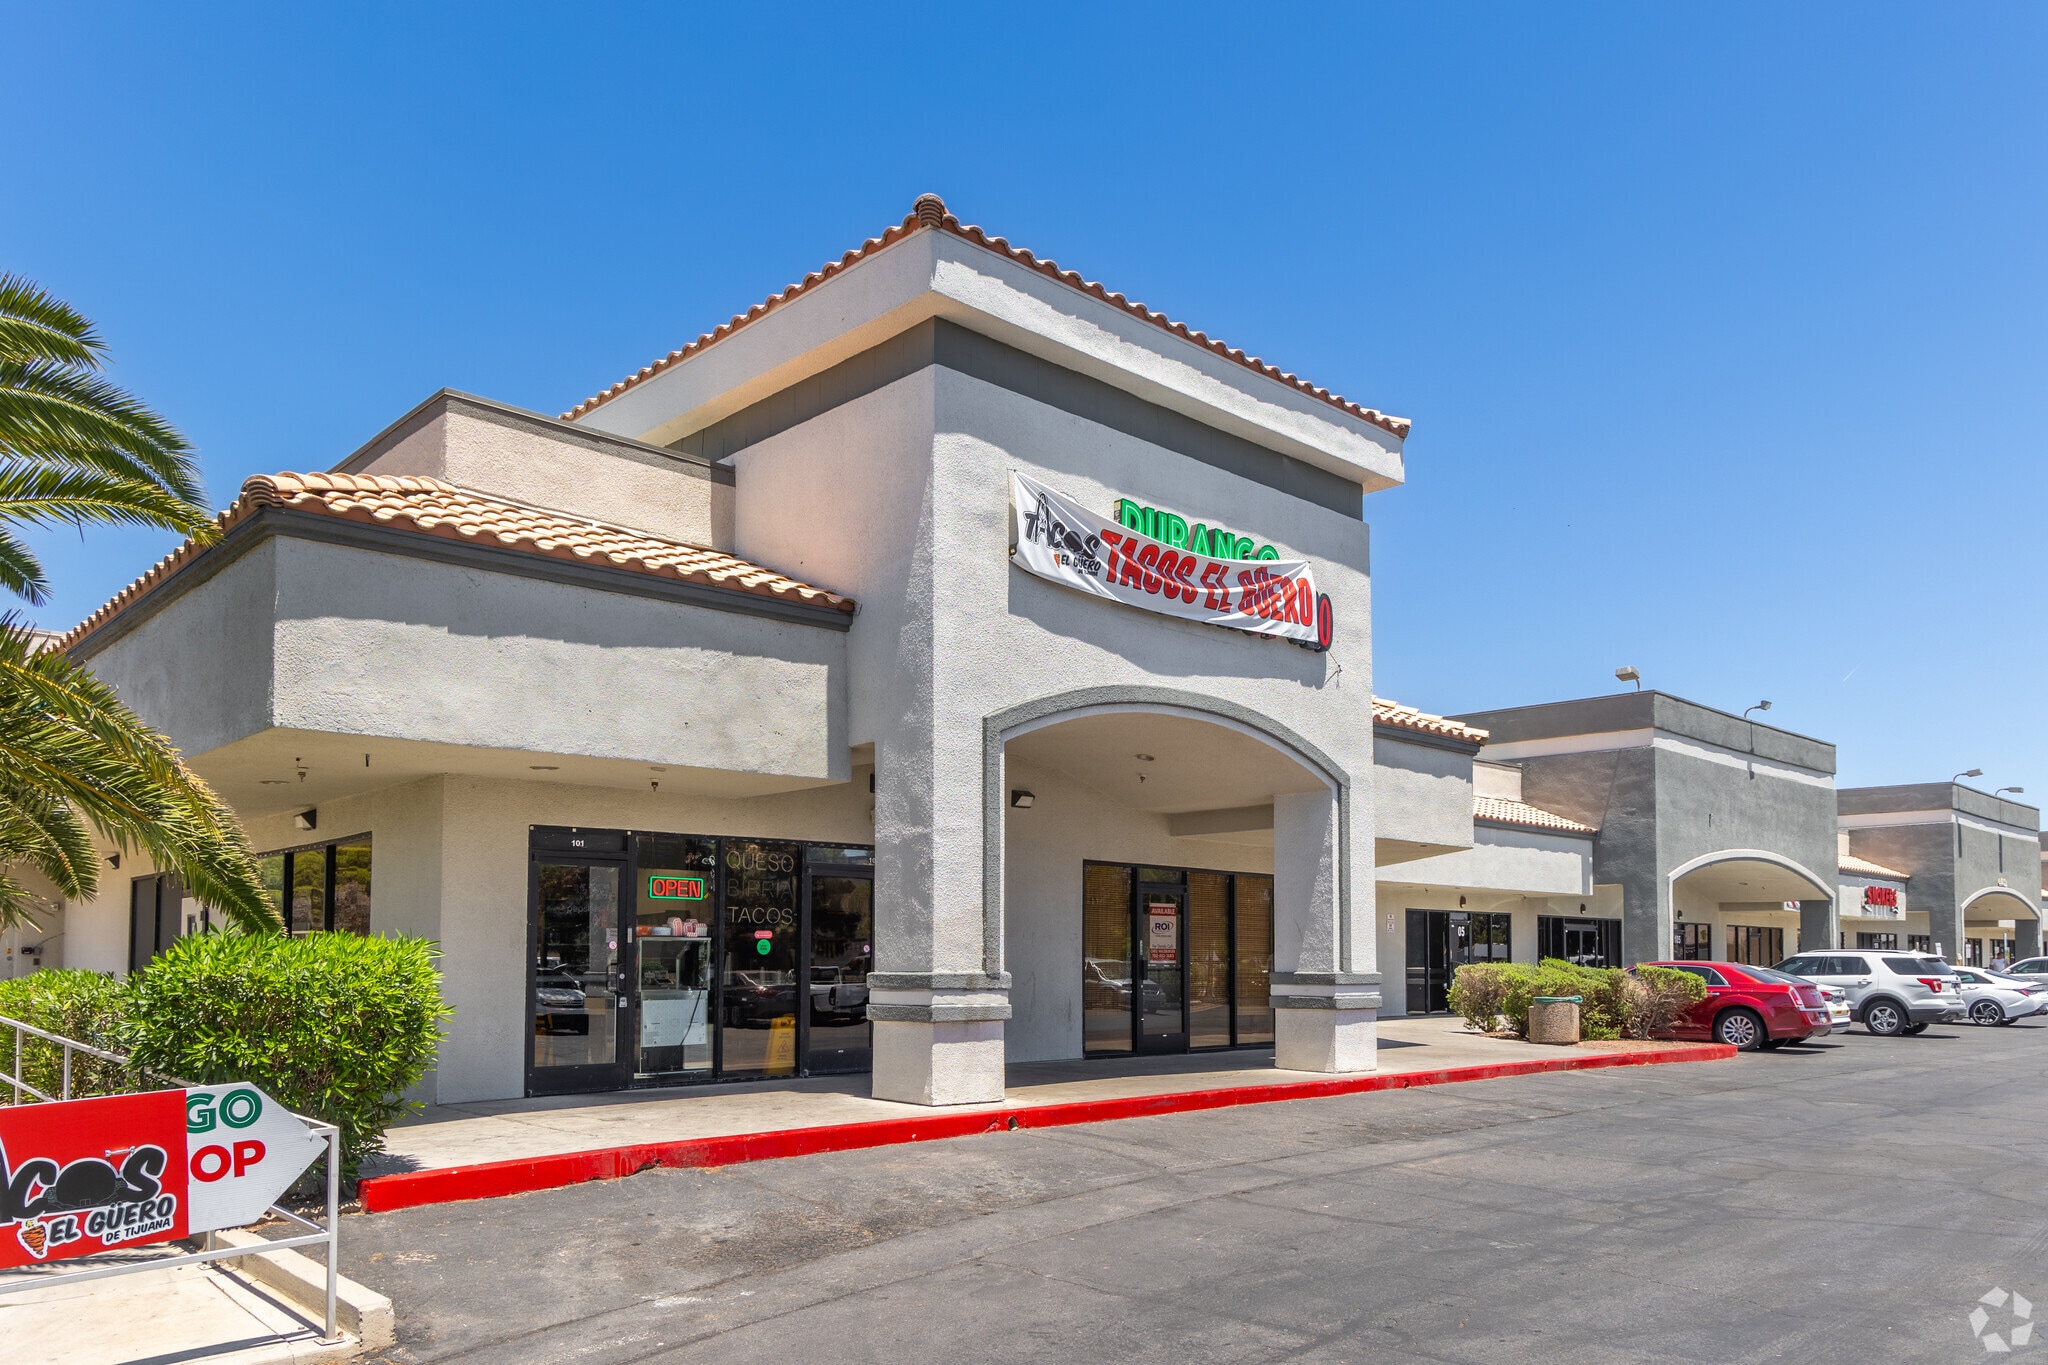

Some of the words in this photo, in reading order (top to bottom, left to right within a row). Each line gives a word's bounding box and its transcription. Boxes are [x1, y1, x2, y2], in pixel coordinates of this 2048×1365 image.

[1061, 554, 1070, 566] EL
[1101, 528, 1199, 604] TACOS
[1201, 562, 1231, 613] EL
[571, 839, 585, 847] 101
[727, 850, 794, 873] QUESO
[652, 879, 700, 899] OPEN
[727, 878, 793, 898] BIRRIA
[727, 906, 793, 924] TACOS
[186, 1089, 262, 1133] GO
[190, 1140, 266, 1182] OP
[49, 1219, 79, 1243] EL
[88, 1196, 175, 1234] GÜERO
[105, 1230, 121, 1241] DE
[124, 1217, 171, 1236] TIJUANA
